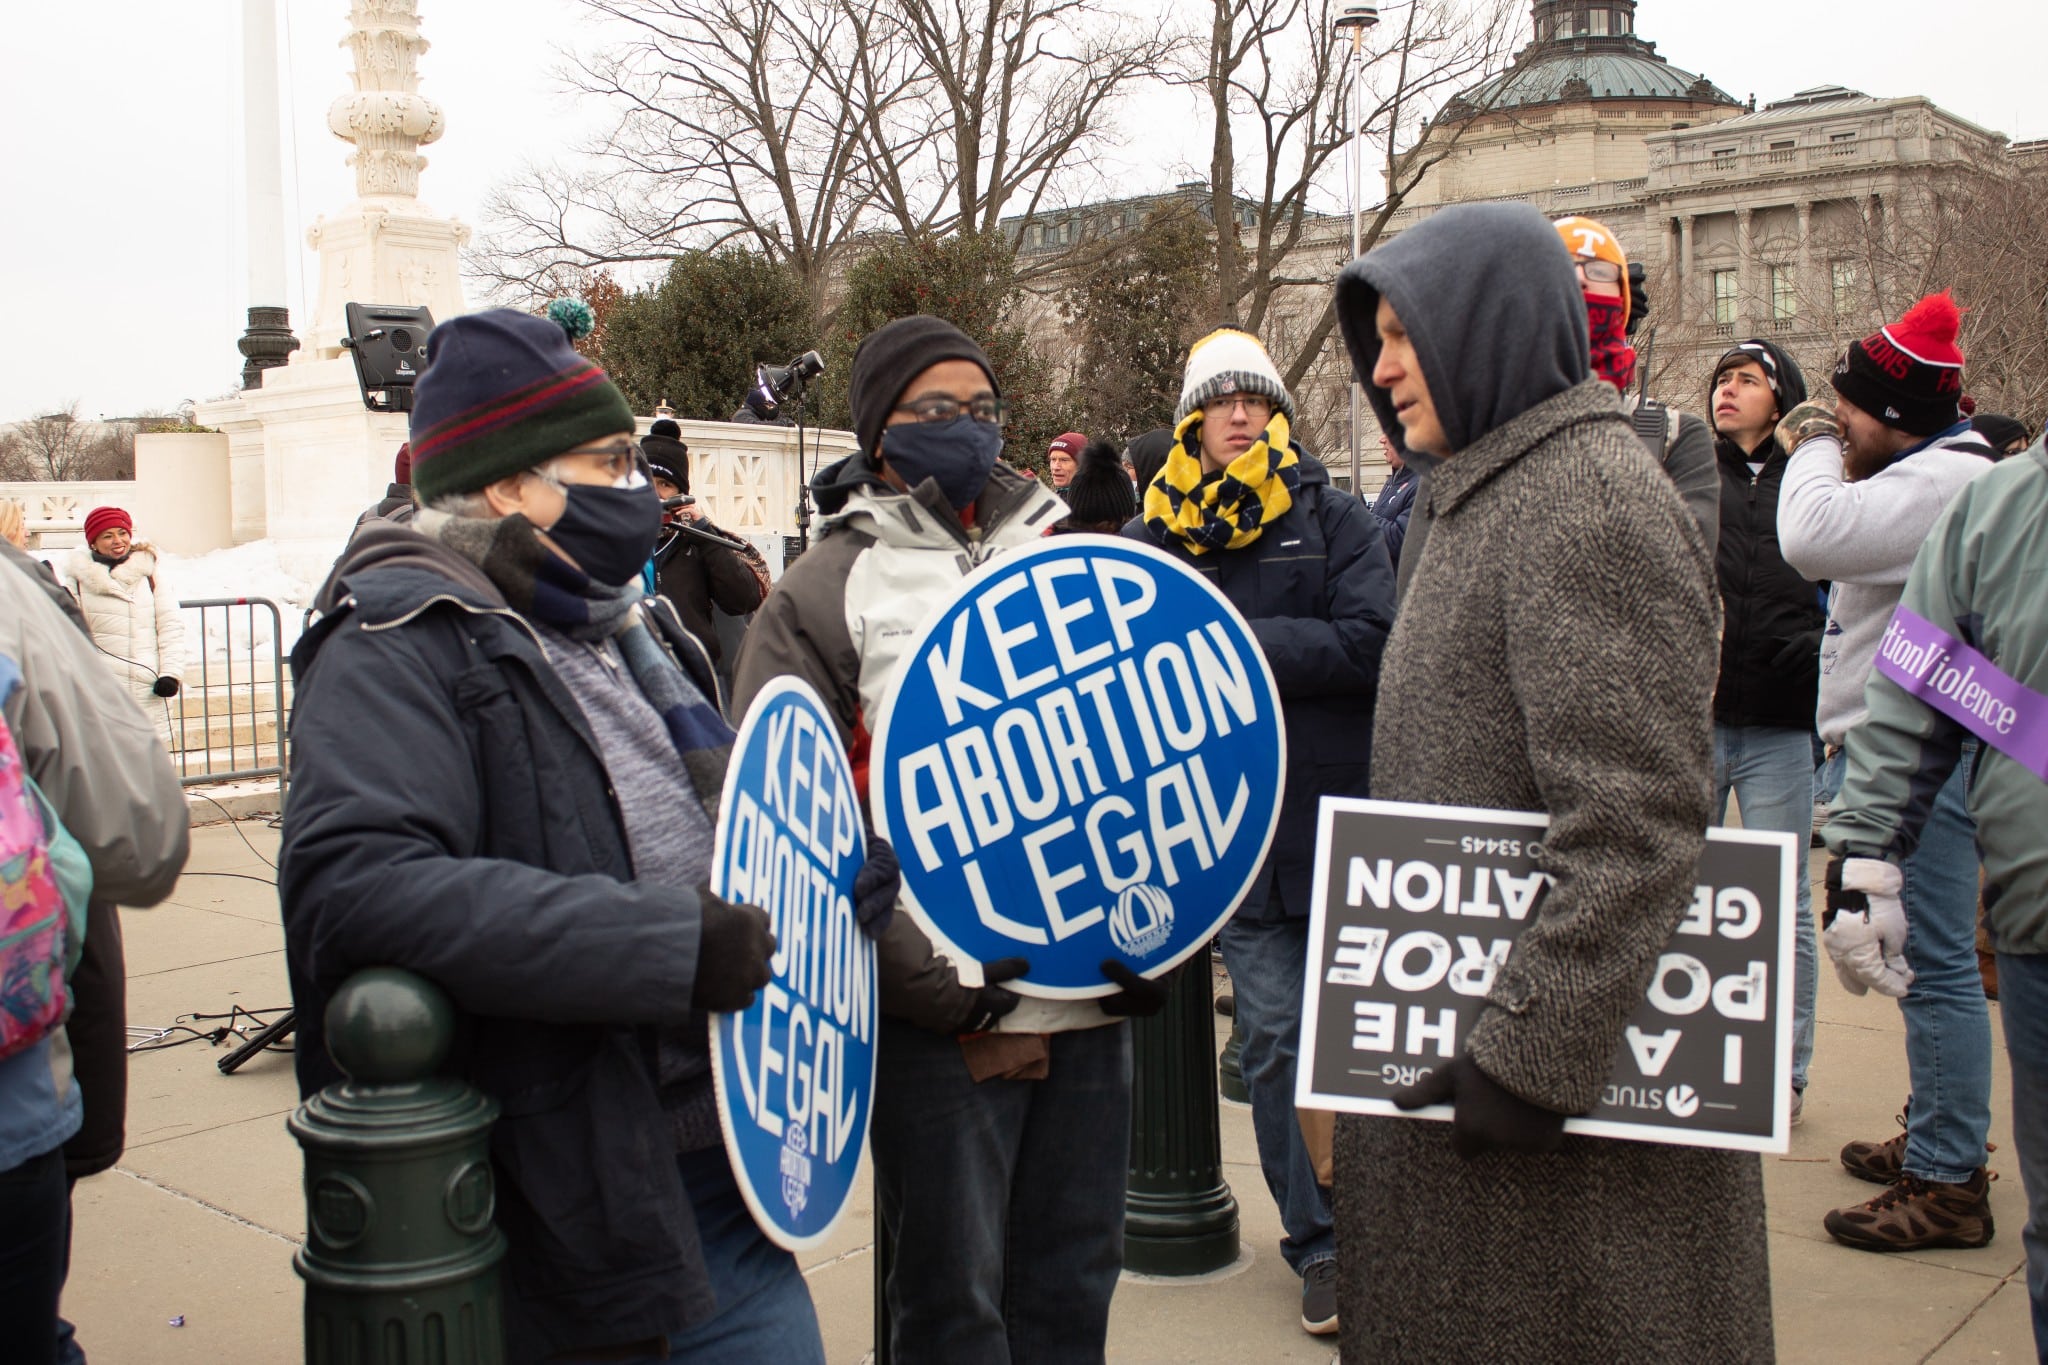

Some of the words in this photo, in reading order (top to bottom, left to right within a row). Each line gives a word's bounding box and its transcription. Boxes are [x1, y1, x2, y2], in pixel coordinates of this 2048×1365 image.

[1572, 228, 1605, 258] T
[1861, 333, 1914, 379] CONS
[926, 556, 1158, 727] KEEP
[898, 620, 1258, 873] ABORTION
[763, 704, 855, 879] KEEP
[962, 754, 1250, 946] LEGAL
[1460, 836, 1521, 858] 53445
[728, 789, 870, 1045] ABORTION
[1326, 926, 1513, 998] ROE
[1646, 953, 1768, 1022] PO
[1352, 1001, 1456, 1058] HE
[1625, 1026, 1682, 1076] A
[1723, 1034, 1742, 1085] I
[733, 988, 857, 1164] LEGAL
